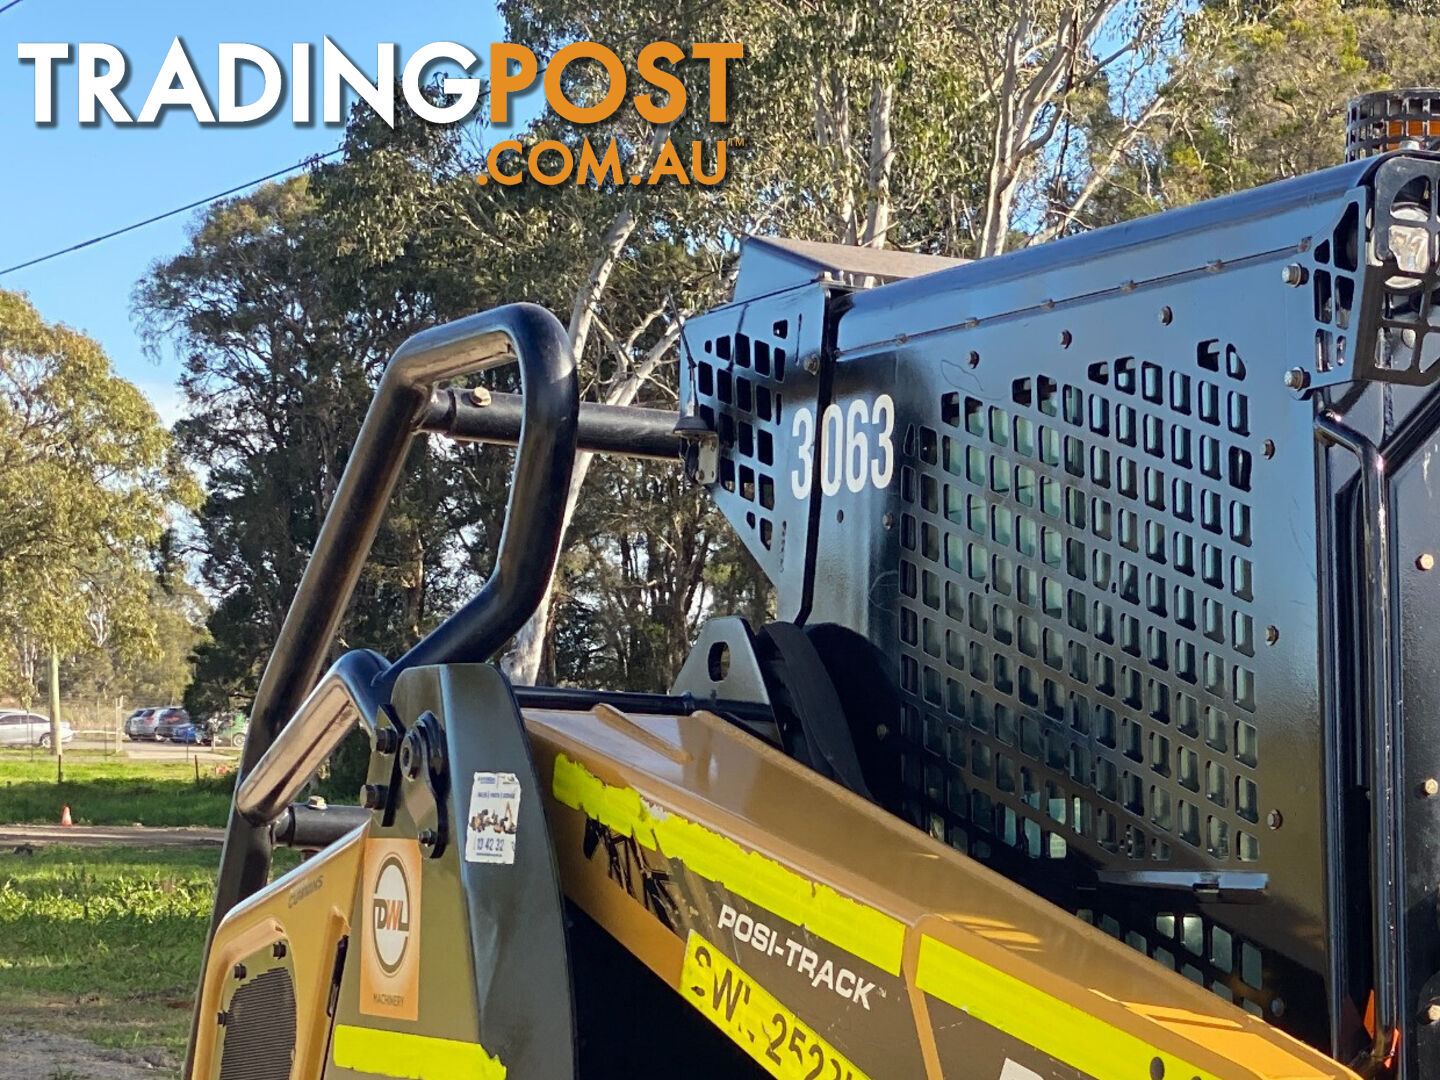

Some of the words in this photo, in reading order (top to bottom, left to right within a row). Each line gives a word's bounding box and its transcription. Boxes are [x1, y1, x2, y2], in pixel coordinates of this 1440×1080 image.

[791, 394, 895, 500] 3063
[373, 898, 410, 931] DWL
[717, 904, 876, 1011] POSI-TRACK
